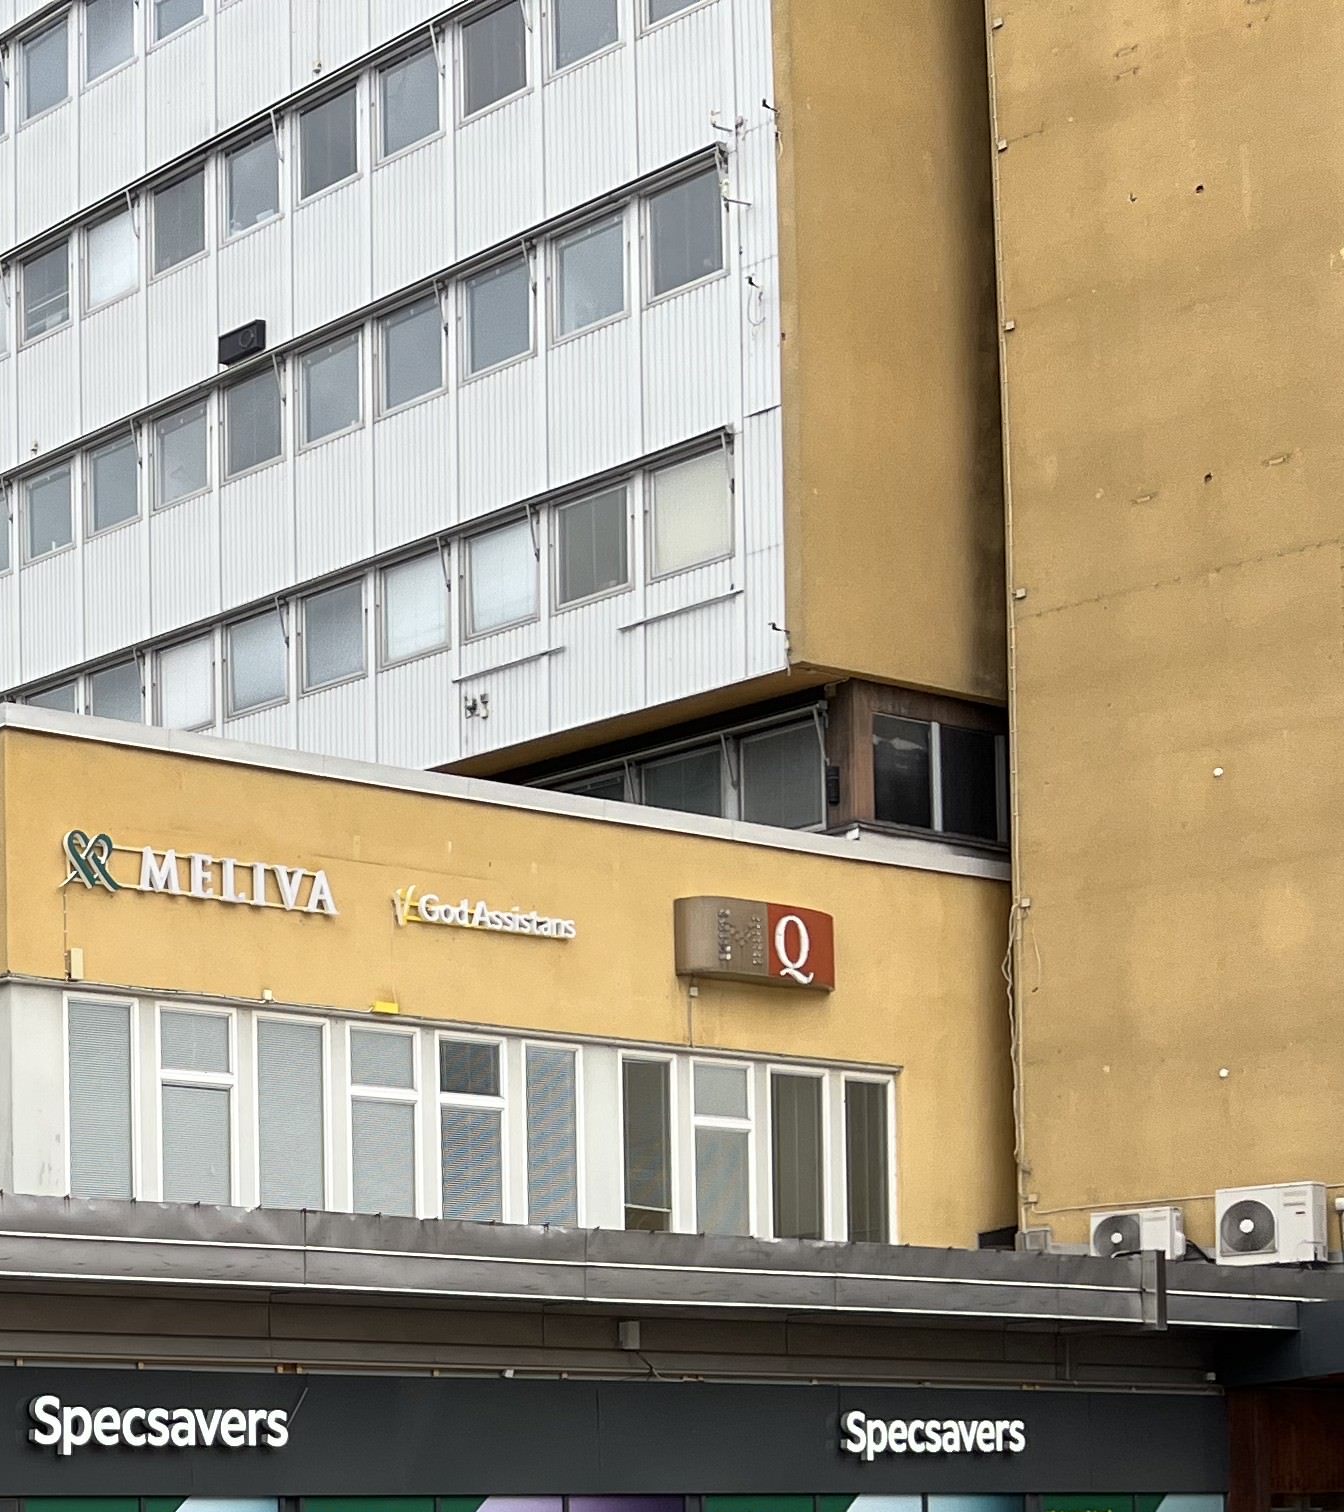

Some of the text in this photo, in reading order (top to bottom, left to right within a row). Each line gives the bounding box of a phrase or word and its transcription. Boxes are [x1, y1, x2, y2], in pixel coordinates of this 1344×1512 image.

[138, 845, 339, 915] MELIVA
[418, 894, 577, 938] God Assistans
[31, 1395, 289, 1456] Specsavers
[843, 1410, 1027, 1461] Specsavers
